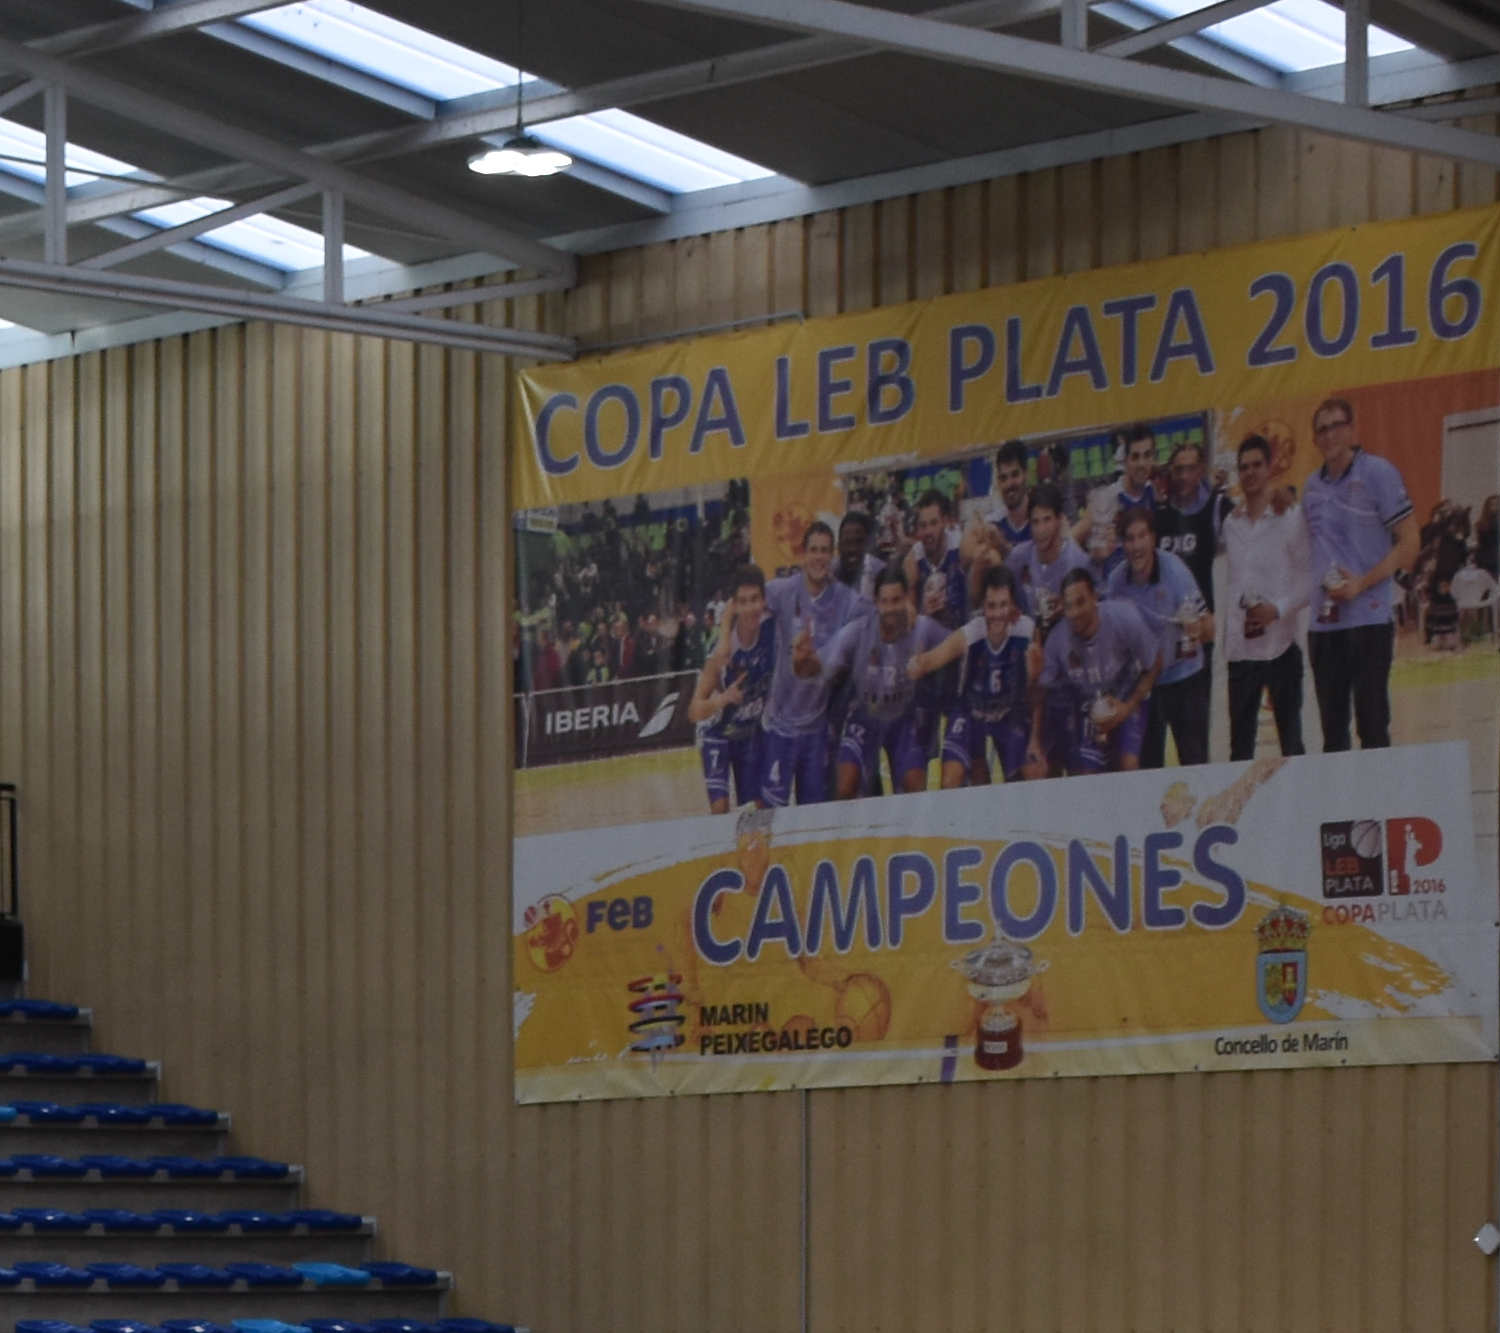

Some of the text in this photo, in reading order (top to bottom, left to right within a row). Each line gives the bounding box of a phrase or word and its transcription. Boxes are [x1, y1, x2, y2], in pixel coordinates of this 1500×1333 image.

[535, 241, 1483, 478] COPA LEB PLATA 2016
[545, 701, 640, 735] IBERIA
[1325, 857, 1361, 876] LEB
[693, 824, 1247, 966] CAMPEONES
[1326, 877, 1375, 892] PLATA
[1414, 880, 1446, 894] 2016
[700, 1025, 853, 1056] PEIXEGALEGO
[1215, 1036, 1277, 1056] Concello
[1282, 1034, 1298, 1053] de
